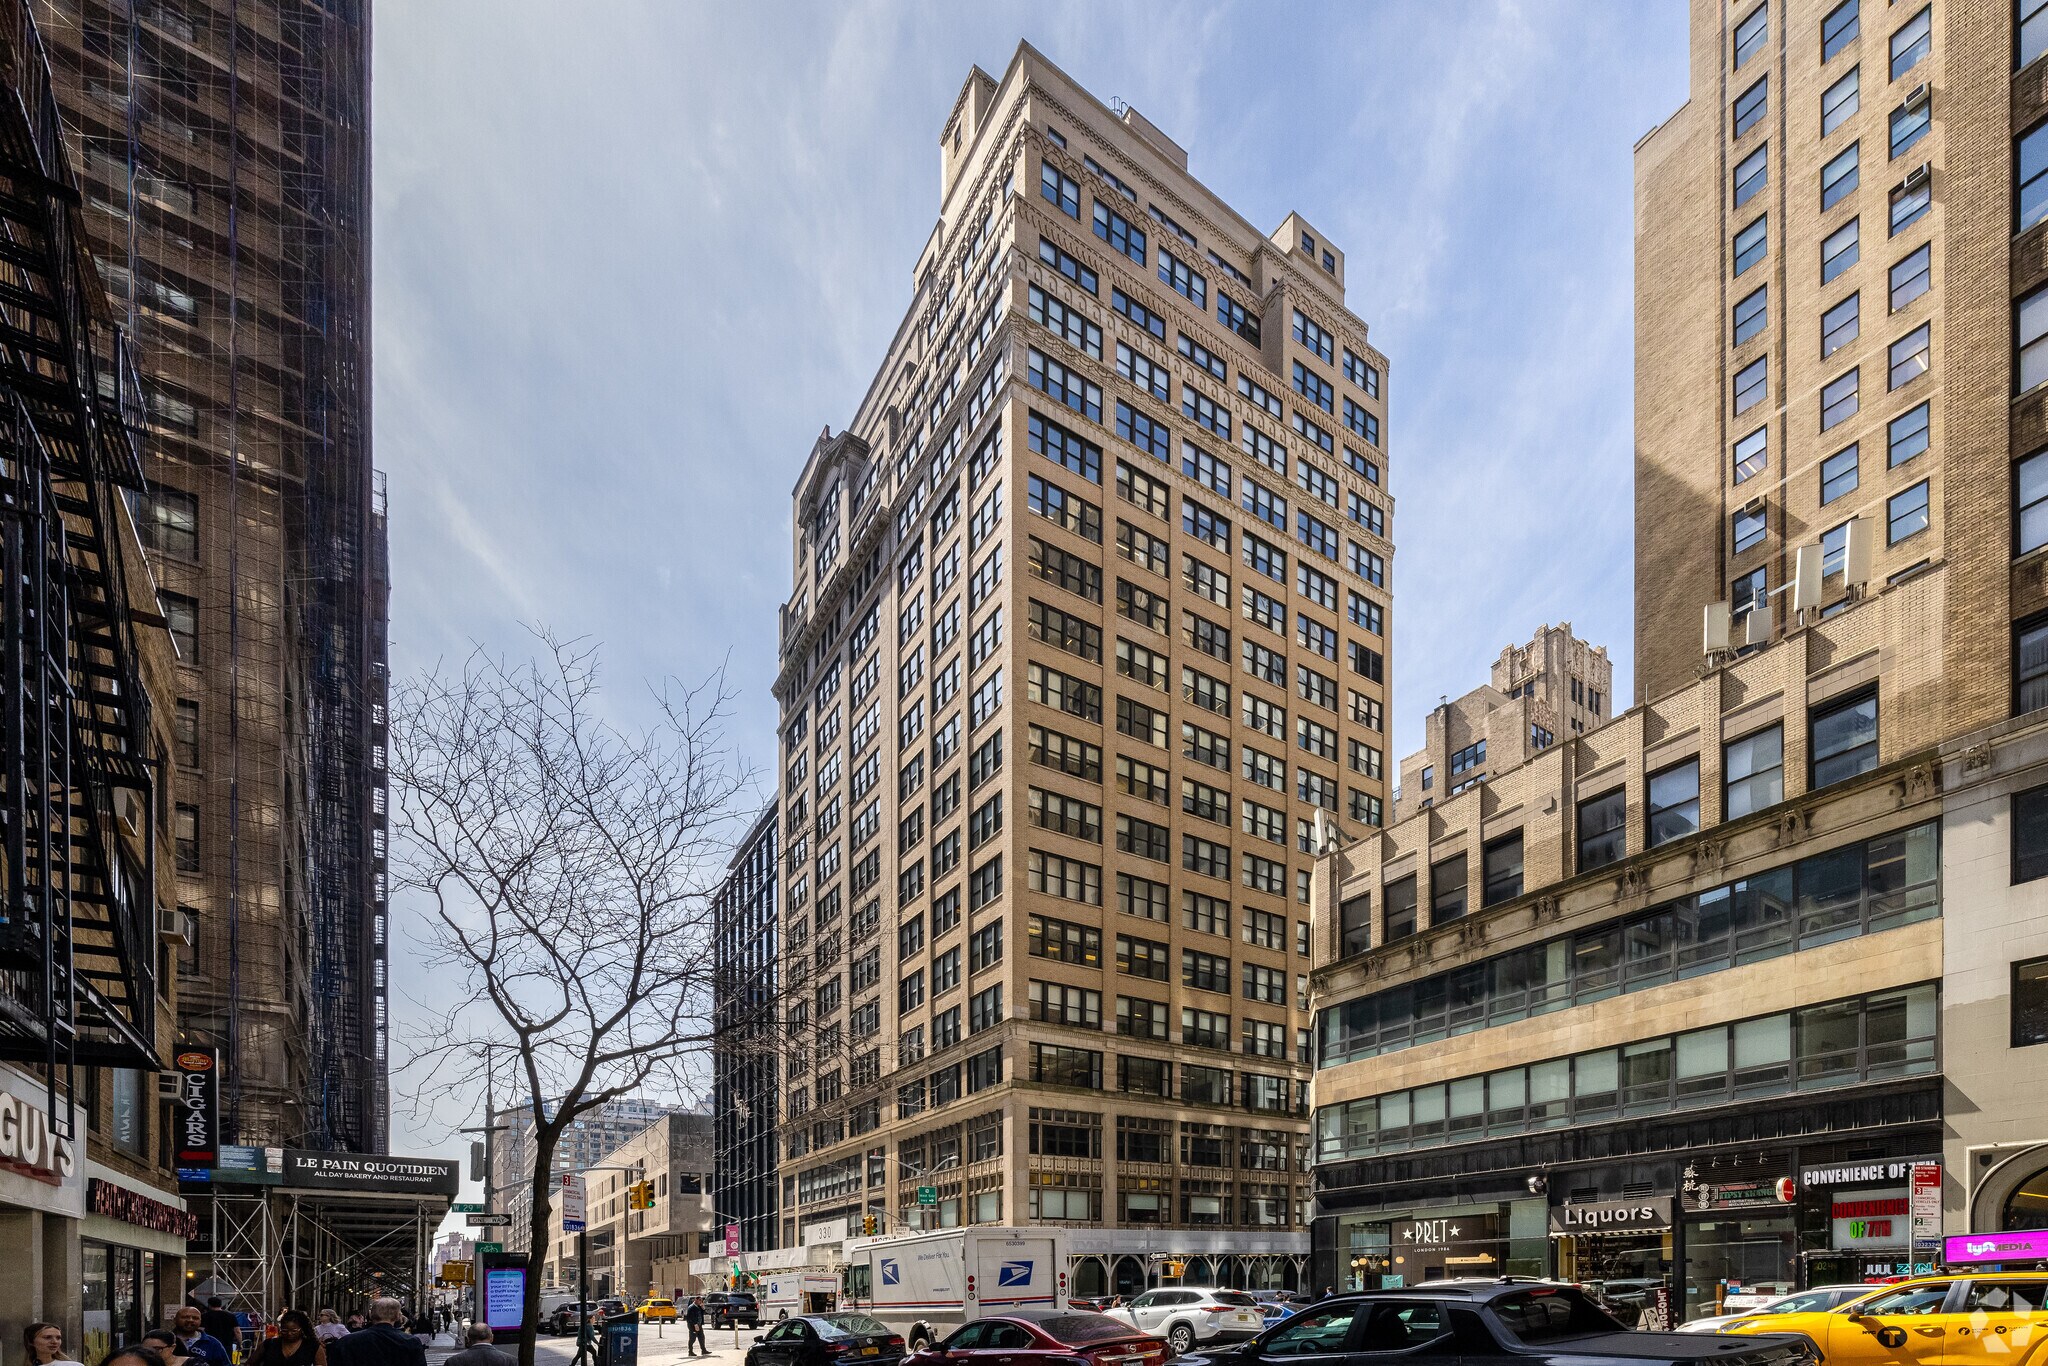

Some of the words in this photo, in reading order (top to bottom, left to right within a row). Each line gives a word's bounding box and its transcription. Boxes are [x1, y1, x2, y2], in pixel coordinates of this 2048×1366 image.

[186, 1074, 207, 1146] CIGARS
[0, 1092, 75, 1178] GUYS
[295, 1157, 318, 1168] LE
[322, 1158, 359, 1171] PAIN
[364, 1162, 448, 1176] QUOTIDIEN
[1804, 1165, 1884, 1186] CONVENIENCE
[1889, 1163, 1906, 1179] OF
[390, 1175, 433, 1183] RESTAURANT
[564, 1176, 569, 1185] 3
[1745, 1188, 1776, 1197] SHANG
[463, 1204, 473, 1212] 29
[1832, 1198, 1910, 1220] CONVENIENCE
[1565, 1206, 1653, 1227] Liquors
[818, 1226, 832, 1240] 330
[1415, 1220, 1448, 1244] PRET
[1849, 1221, 1866, 1239] OF
[1867, 1220, 1892, 1238] 7TH
[1967, 1242, 1996, 1256] lyft
[1865, 1264, 1892, 1275] JUUL
[621, 1336, 632, 1352] P
[1884, 1330, 1900, 1345] T
